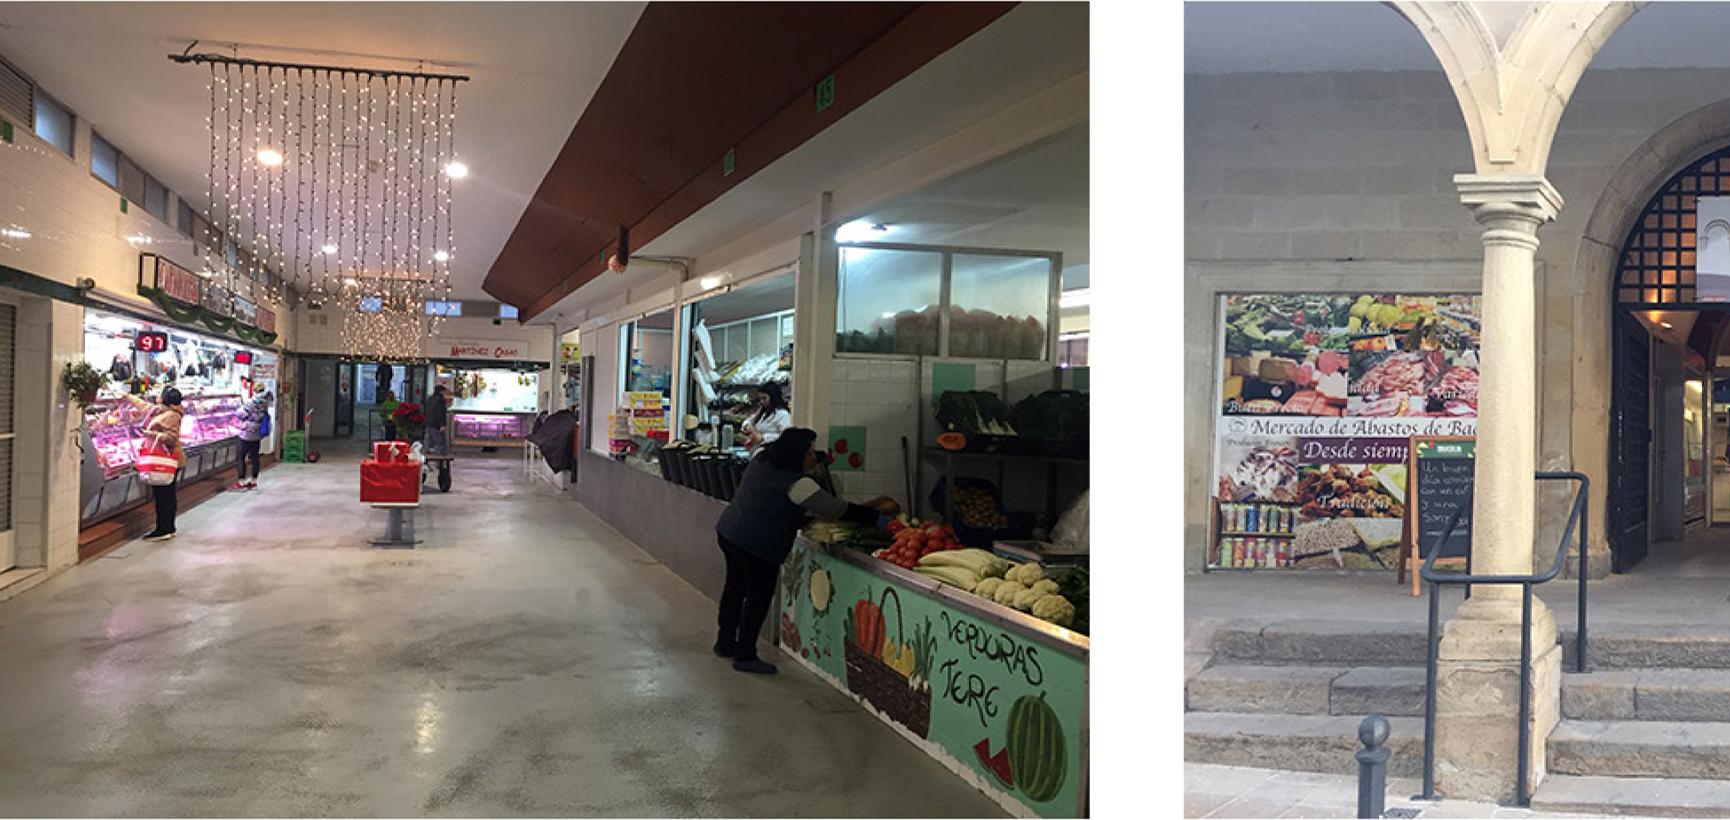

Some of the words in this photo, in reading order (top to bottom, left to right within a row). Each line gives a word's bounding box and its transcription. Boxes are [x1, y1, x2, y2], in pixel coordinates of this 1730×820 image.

[141, 336, 164, 351] 97
[1251, 419, 1325, 435] Mercado
[1329, 418, 1348, 435] de
[1351, 419, 1418, 435] Abastos
[1423, 418, 1442, 435] de
[1303, 437, 1357, 459] Desde
[940, 610, 1043, 687] VERDURAS
[940, 658, 999, 728] TERE
